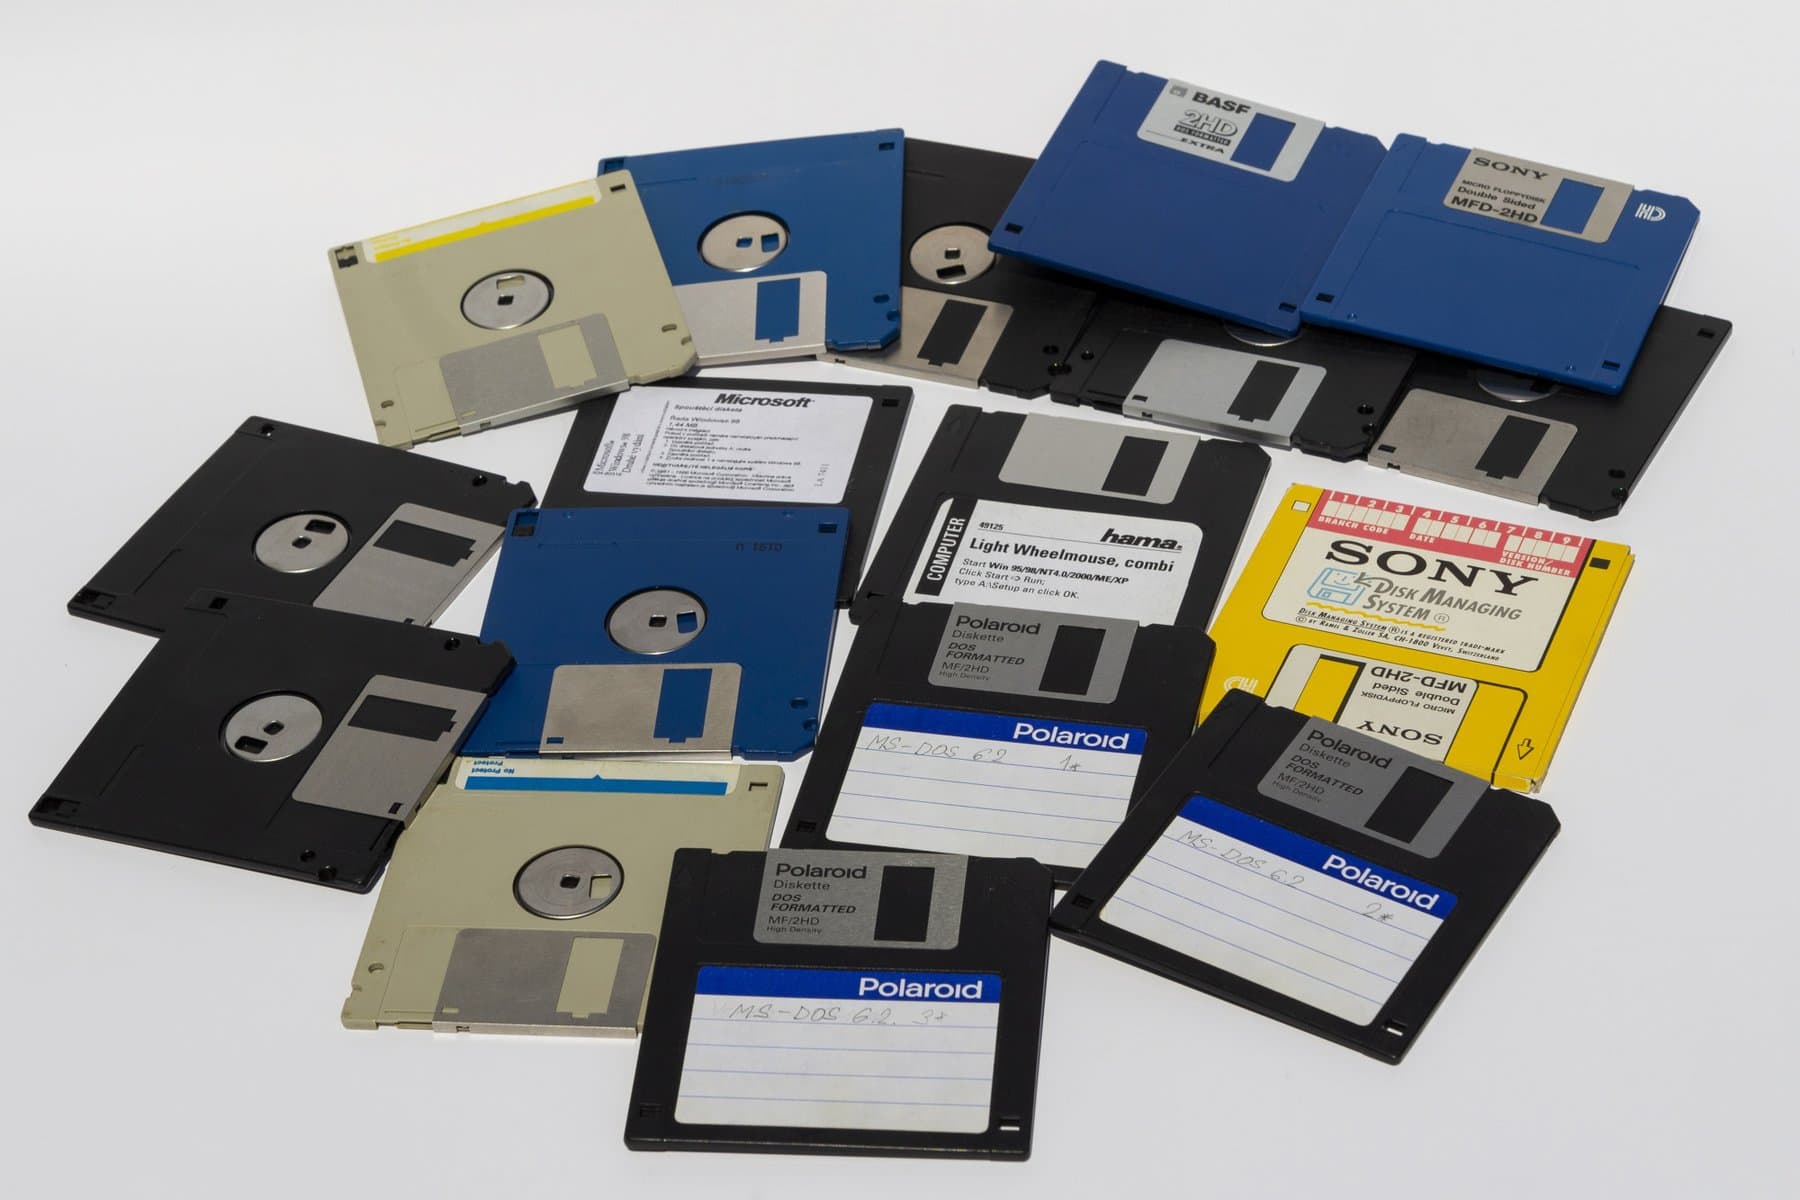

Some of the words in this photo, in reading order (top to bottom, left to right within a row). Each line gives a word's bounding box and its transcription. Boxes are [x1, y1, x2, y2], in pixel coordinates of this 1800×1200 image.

[1192, 91, 1251, 114] BASF
[1178, 109, 1238, 136] 2HD
[1181, 138, 1224, 154] EXTRA
[1473, 157, 1549, 180] SONY
[1462, 179, 1491, 190] MICRO
[1457, 186, 1498, 201] Double
[1502, 196, 1537, 210] Sided
[1451, 195, 1539, 223] MFD-2HD
[714, 393, 812, 408] Microsoft
[979, 521, 1005, 531] 49125
[1318, 515, 1359, 529] BRANCH
[1363, 524, 1390, 535] CODE
[1343, 494, 1350, 502] 1
[1368, 500, 1378, 508] 2
[1395, 505, 1404, 513] 3
[1422, 510, 1433, 519] 4
[1450, 515, 1461, 524] 5
[1479, 520, 1488, 529] 6
[1534, 531, 1544, 539] 8
[1562, 536, 1572, 544] 9
[1409, 533, 1436, 544] DATE
[926, 517, 966, 581] COMPUTER
[970, 538, 1010, 553] Light
[1014, 543, 1120, 568] Wheelmouse,
[1124, 558, 1175, 573] combi
[959, 567, 983, 577] Click
[985, 571, 1009, 581] Start
[962, 558, 987, 568] Start
[988, 561, 1009, 571] Win
[1324, 539, 1540, 597] SONY
[1500, 558, 1523, 568] DISK
[1527, 562, 1572, 577] NUMBER
[955, 577, 976, 586] type
[1022, 586, 1036, 594] an
[1037, 587, 1062, 598] click
[1063, 589, 1081, 599] OK.
[1362, 594, 1432, 621] SYSTEM
[1374, 577, 1420, 601] DISK
[1418, 588, 1523, 621] MANAGING
[956, 615, 1041, 635] Polaroid
[1298, 607, 1316, 616] DISK
[1318, 611, 1358, 626] MANAGING
[1360, 619, 1388, 631] SYSTEM
[1418, 633, 1458, 645] REGISTERED
[1460, 641, 1506, 655] TRADE-MARK
[952, 629, 1005, 643] Diskette
[1393, 635, 1430, 647] CH-1800
[947, 642, 977, 651] DOS
[941, 661, 990, 674] MF/2HD
[945, 651, 1025, 665] FORMATTED
[939, 670, 958, 679] High
[960, 672, 991, 681] Density
[1370, 665, 1468, 694] MFD-2HD
[1372, 682, 1410, 696] Sided
[1415, 690, 1461, 706] Double
[1361, 691, 1420, 708] FLOPPYDISK
[1423, 703, 1456, 715] MICRO
[1013, 722, 1130, 750] Polaroid
[1356, 720, 1443, 746] SONY
[1299, 743, 1351, 768] Diskette
[1307, 729, 1393, 769] Polaroid
[1290, 755, 1320, 769] DOS
[1277, 772, 1325, 795] MF/2HD
[1285, 762, 1364, 795] FORMATTED
[776, 863, 868, 879] Polaroid
[773, 879, 831, 891] Diskette
[1322, 854, 1440, 910] Polaroid
[771, 893, 802, 902] DOS
[770, 903, 857, 914] FORMATTED
[767, 925, 787, 933] High
[789, 926, 822, 934] Density
[768, 915, 820, 926] MF/2HD
[858, 976, 982, 1000] Polaroid
